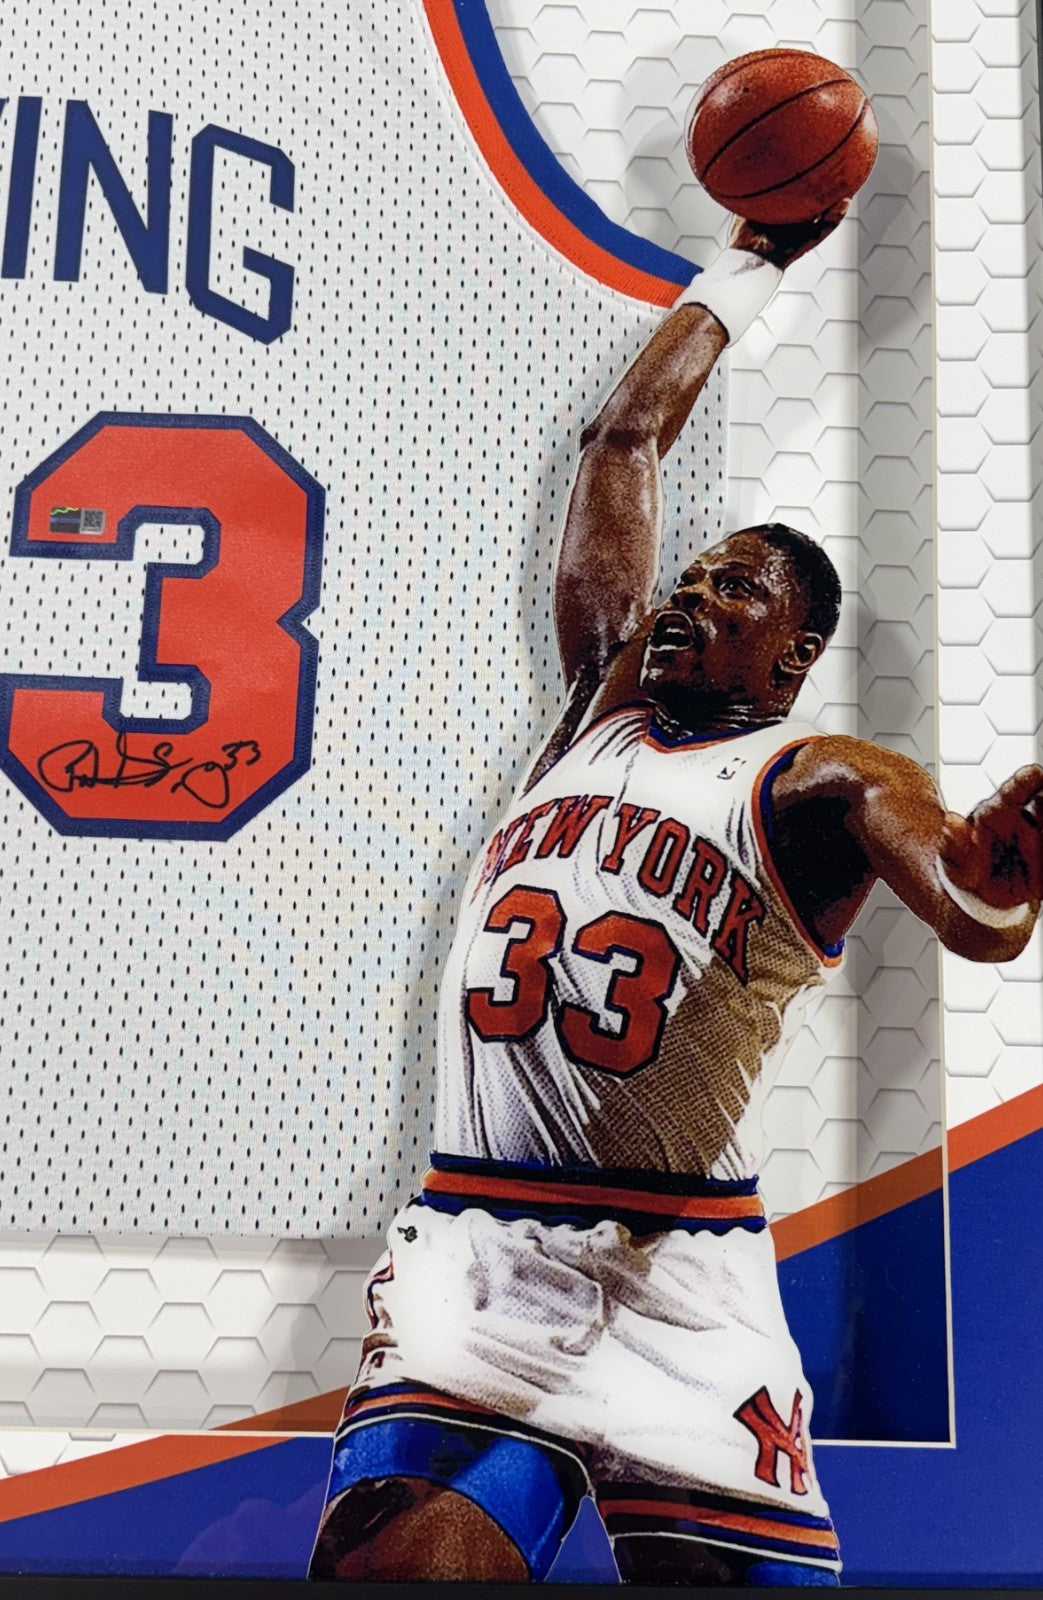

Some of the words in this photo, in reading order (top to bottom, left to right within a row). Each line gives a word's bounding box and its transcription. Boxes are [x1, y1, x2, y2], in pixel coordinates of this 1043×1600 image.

[0, 96, 295, 345] ING
[467, 884, 682, 1079] 33
[474, 795, 614, 894] NEW
[601, 803, 766, 987] YORK
